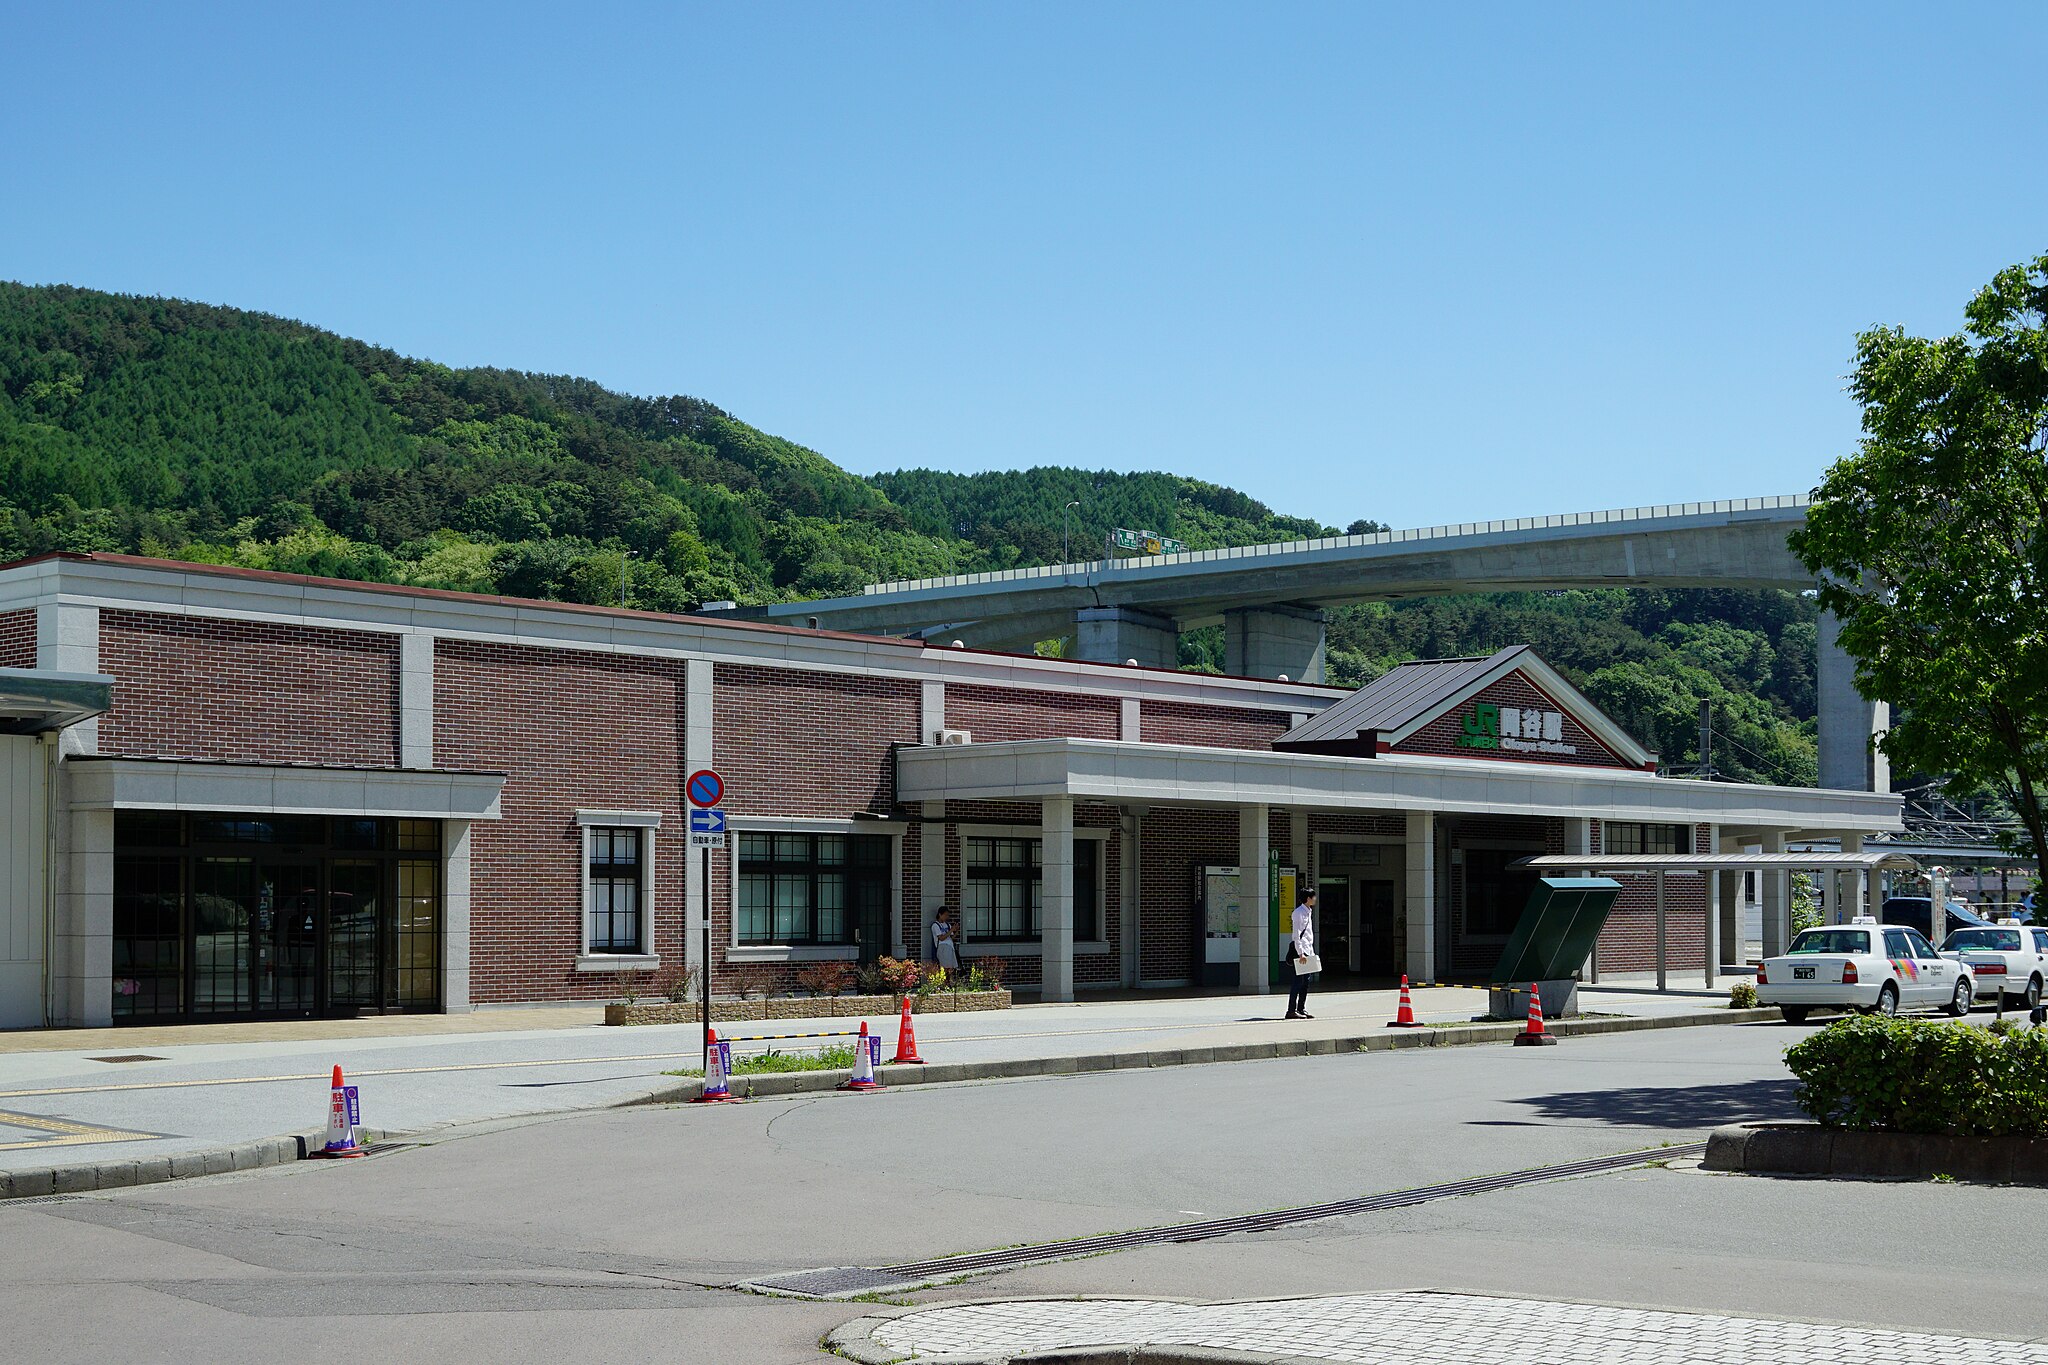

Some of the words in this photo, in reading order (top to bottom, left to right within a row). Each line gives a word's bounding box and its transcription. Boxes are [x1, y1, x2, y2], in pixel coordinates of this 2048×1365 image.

[1463, 704, 1498, 736] JR
[1502, 738, 1537, 753] Okaya
[1538, 741, 1577, 755] Station
